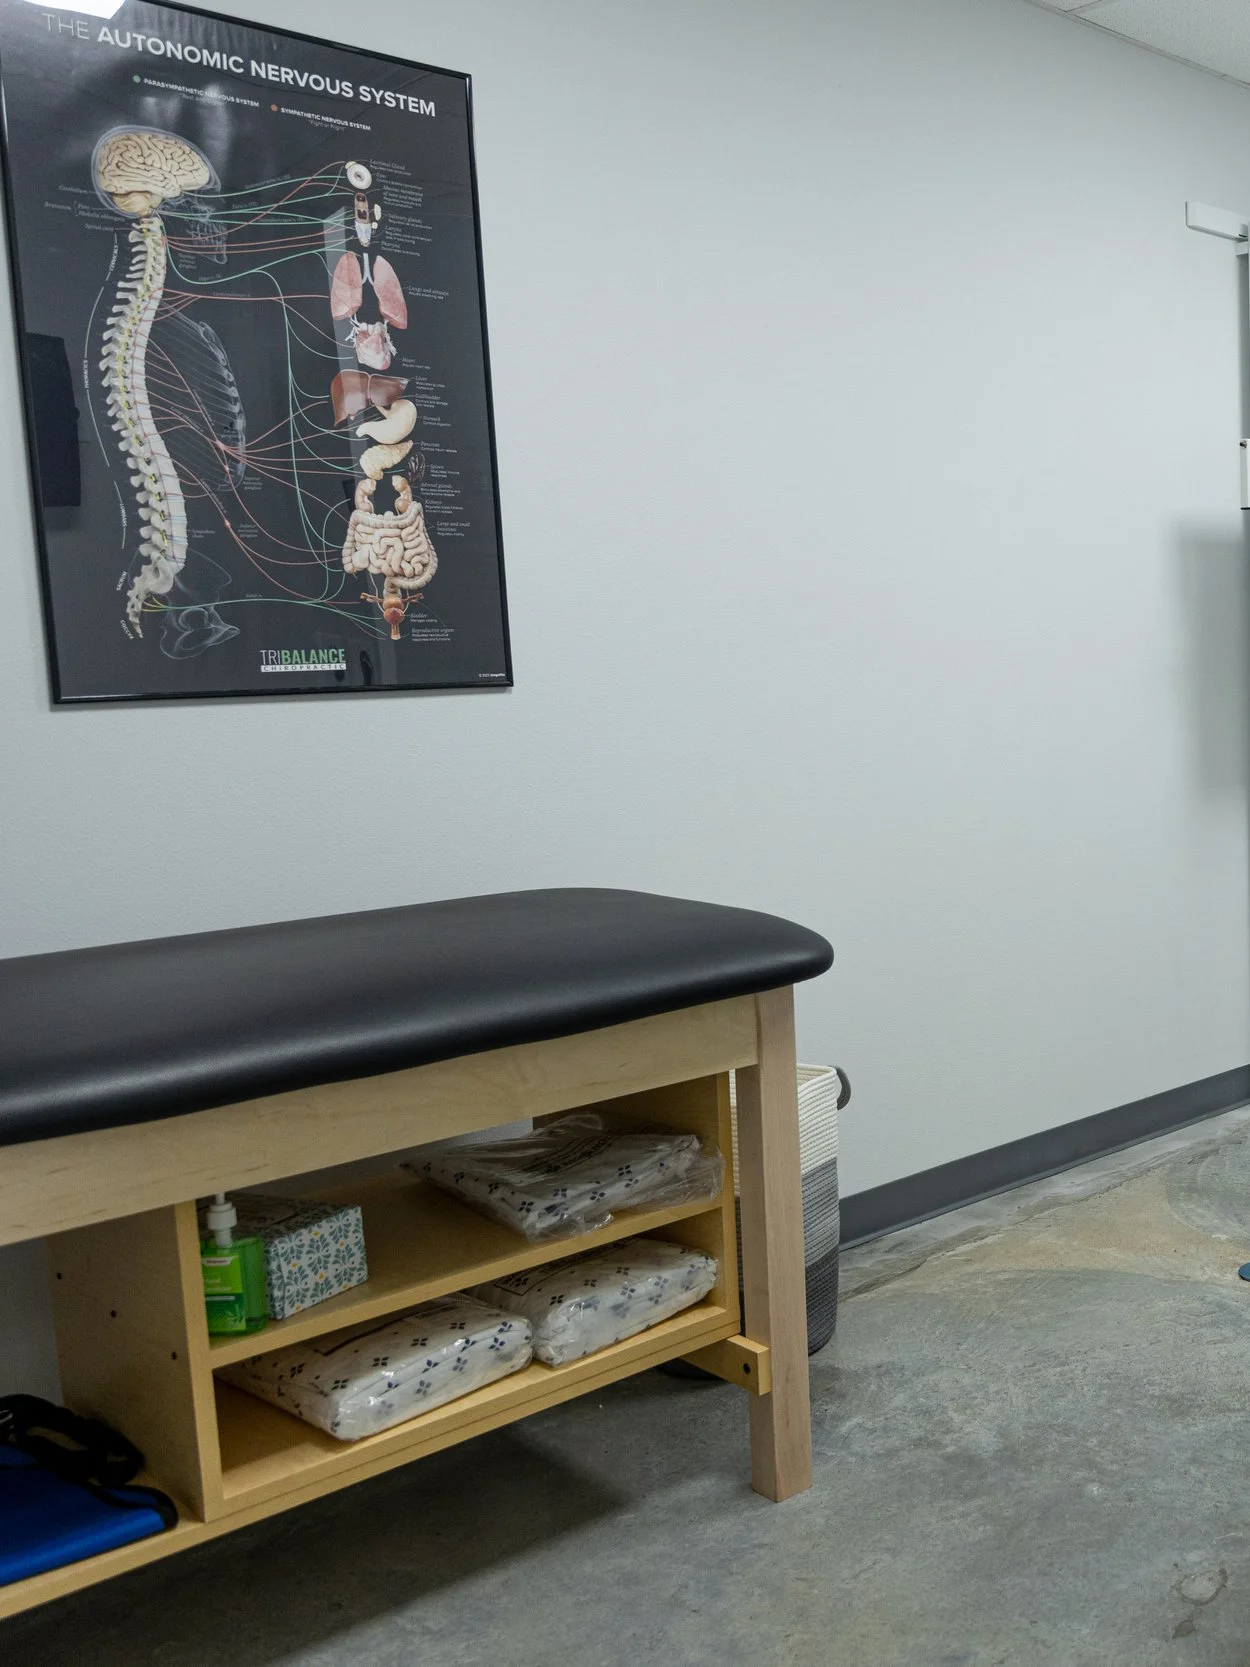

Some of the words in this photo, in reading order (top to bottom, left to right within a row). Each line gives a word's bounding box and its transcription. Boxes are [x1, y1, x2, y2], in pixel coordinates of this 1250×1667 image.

[41, 13, 90, 40] THE
[97, 26, 245, 74] AUTONOMIC
[250, 59, 354, 98] NERVOUS
[358, 85, 436, 117] SYSTEM
[143, 78, 204, 96] PARASYMPATHETIC
[204, 90, 235, 102] NERVOUS
[235, 96, 260, 108] SYSTEM
[280, 107, 321, 120] SYMPATHETIC
[321, 115, 349, 127] NERVOUS
[349, 121, 372, 131] SYSTEM
[260, 648, 347, 665] TRIBALANCE
[263, 664, 344, 672] CHIROPRACTIC
